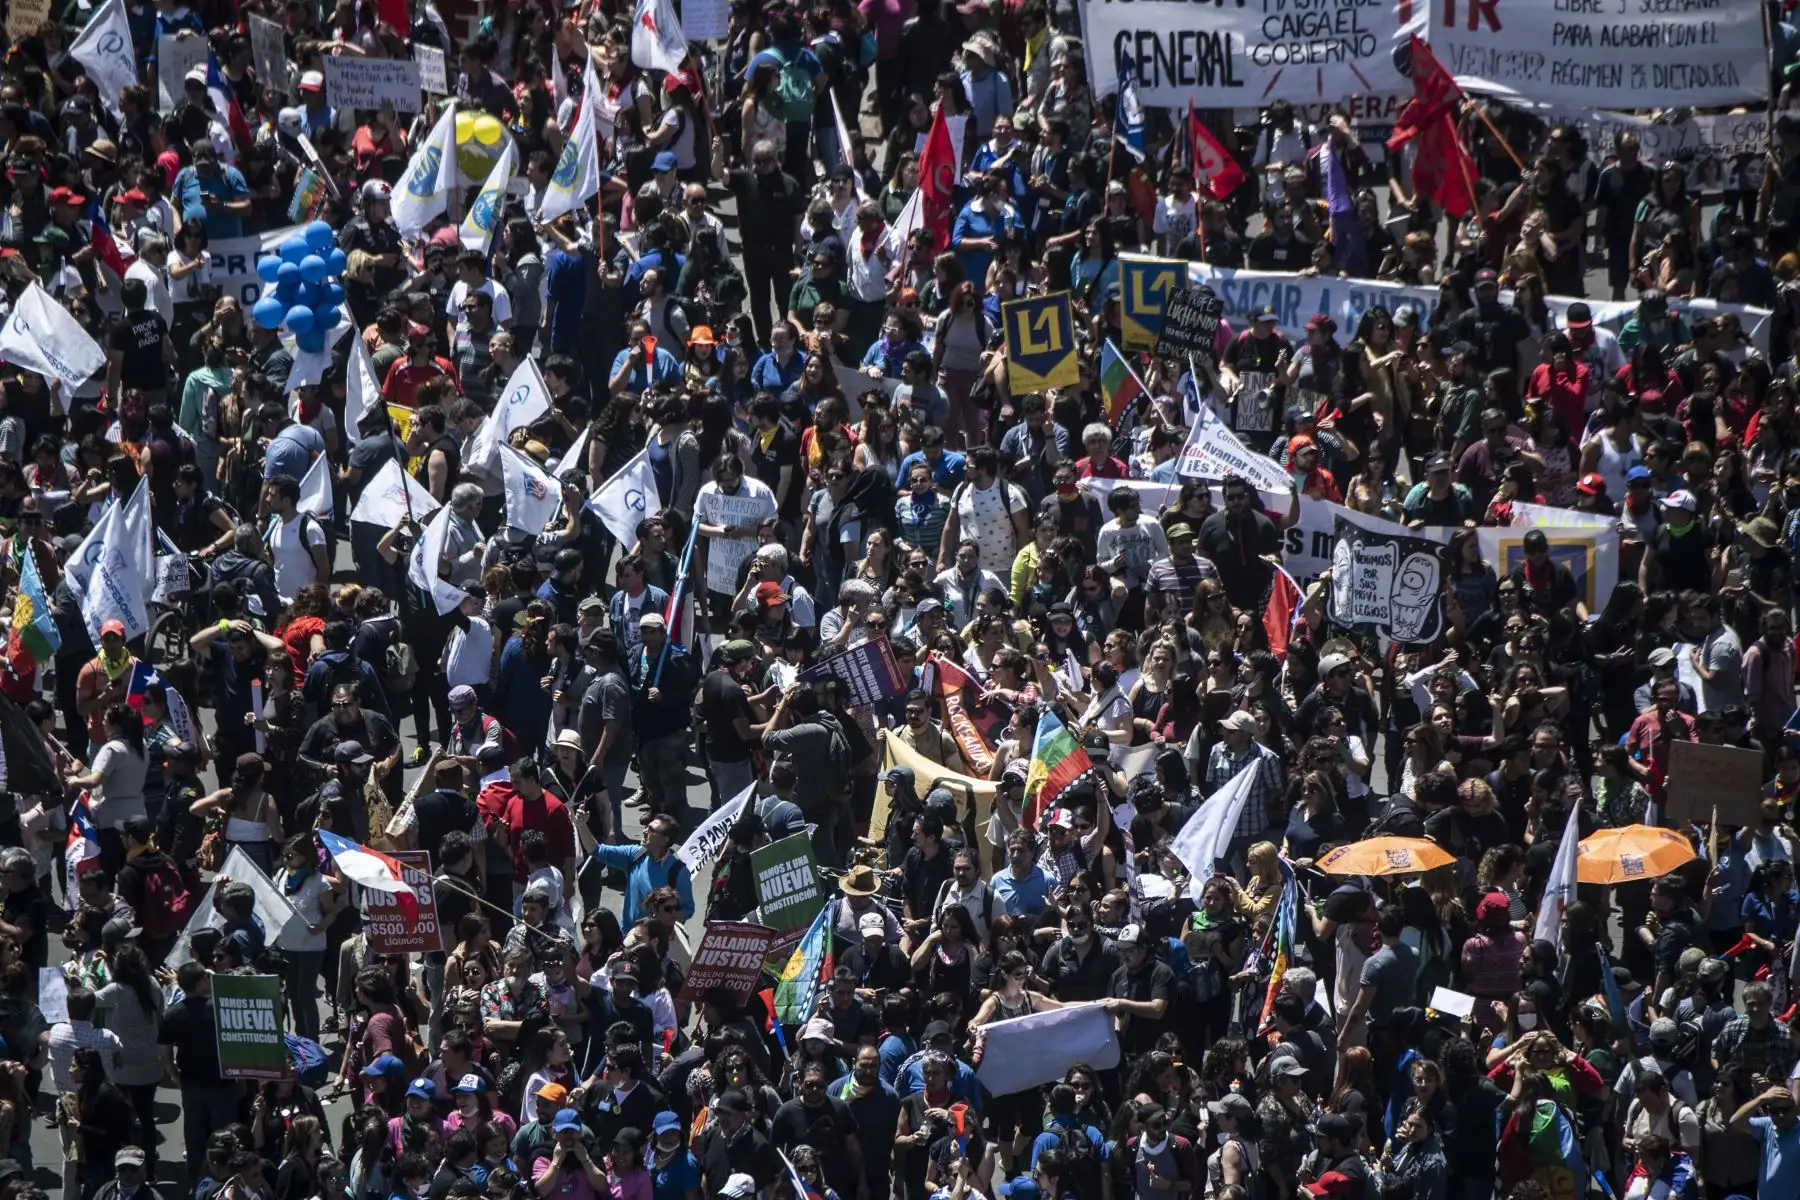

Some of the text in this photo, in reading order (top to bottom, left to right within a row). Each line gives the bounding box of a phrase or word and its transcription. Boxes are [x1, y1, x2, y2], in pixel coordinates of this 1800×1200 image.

[1552, 22, 1593, 47] PARA
[1701, 21, 1719, 44] EL
[1252, 34, 1377, 67] GOBIERNO
[1551, 58, 1623, 88] RÉGIMEN
[1652, 61, 1741, 90] DICTADURA
[1166, 300, 1218, 331] LUCHANDO
[1220, 278, 1300, 329] SACAR
[133, 319, 158, 336] PROFE
[1202, 441, 1249, 472] Avanzar
[1247, 467, 1262, 481] en
[1359, 578, 1377, 591] SUS
[1363, 568, 1379, 582] POR
[100, 566, 140, 630] PROFESORES
[856, 647, 883, 700] ESTE GOBIERNO
[759, 854, 809, 882] VAMOS X UNA
[365, 885, 431, 907] JUSS
[760, 865, 815, 903] NUEVA
[764, 887, 818, 915] CONSTITUCIÓN
[704, 935, 769, 952] SALARIOS
[696, 951, 763, 970] JUSTOS
[691, 970, 757, 982] SUELDO MÍNIMO
[219, 997, 274, 1009] VAMOS X UNA
[219, 1008, 278, 1031] NUEVA
[221, 1031, 279, 1044] CONSTITUCIÓN
